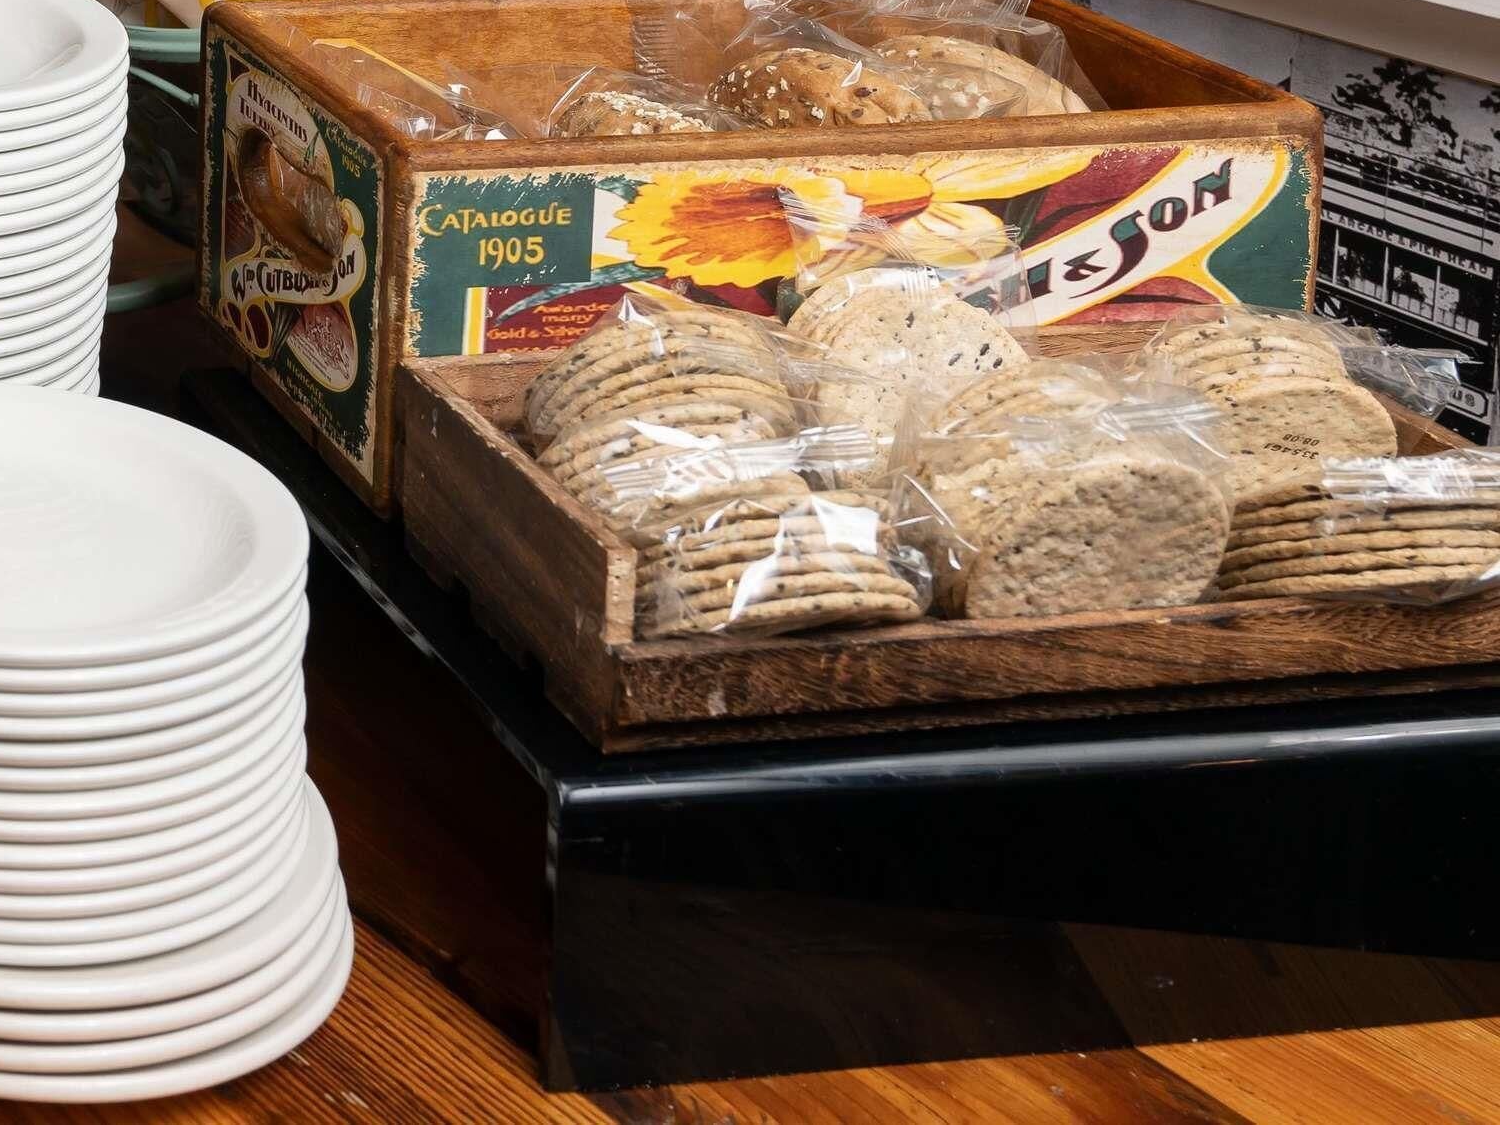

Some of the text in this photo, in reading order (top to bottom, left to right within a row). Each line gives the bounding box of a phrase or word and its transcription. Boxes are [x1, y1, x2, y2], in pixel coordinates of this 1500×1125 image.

[419, 202, 573, 236] CATALOGUE
[478, 236, 546, 270] 1905
[486, 326, 527, 340] Gold
